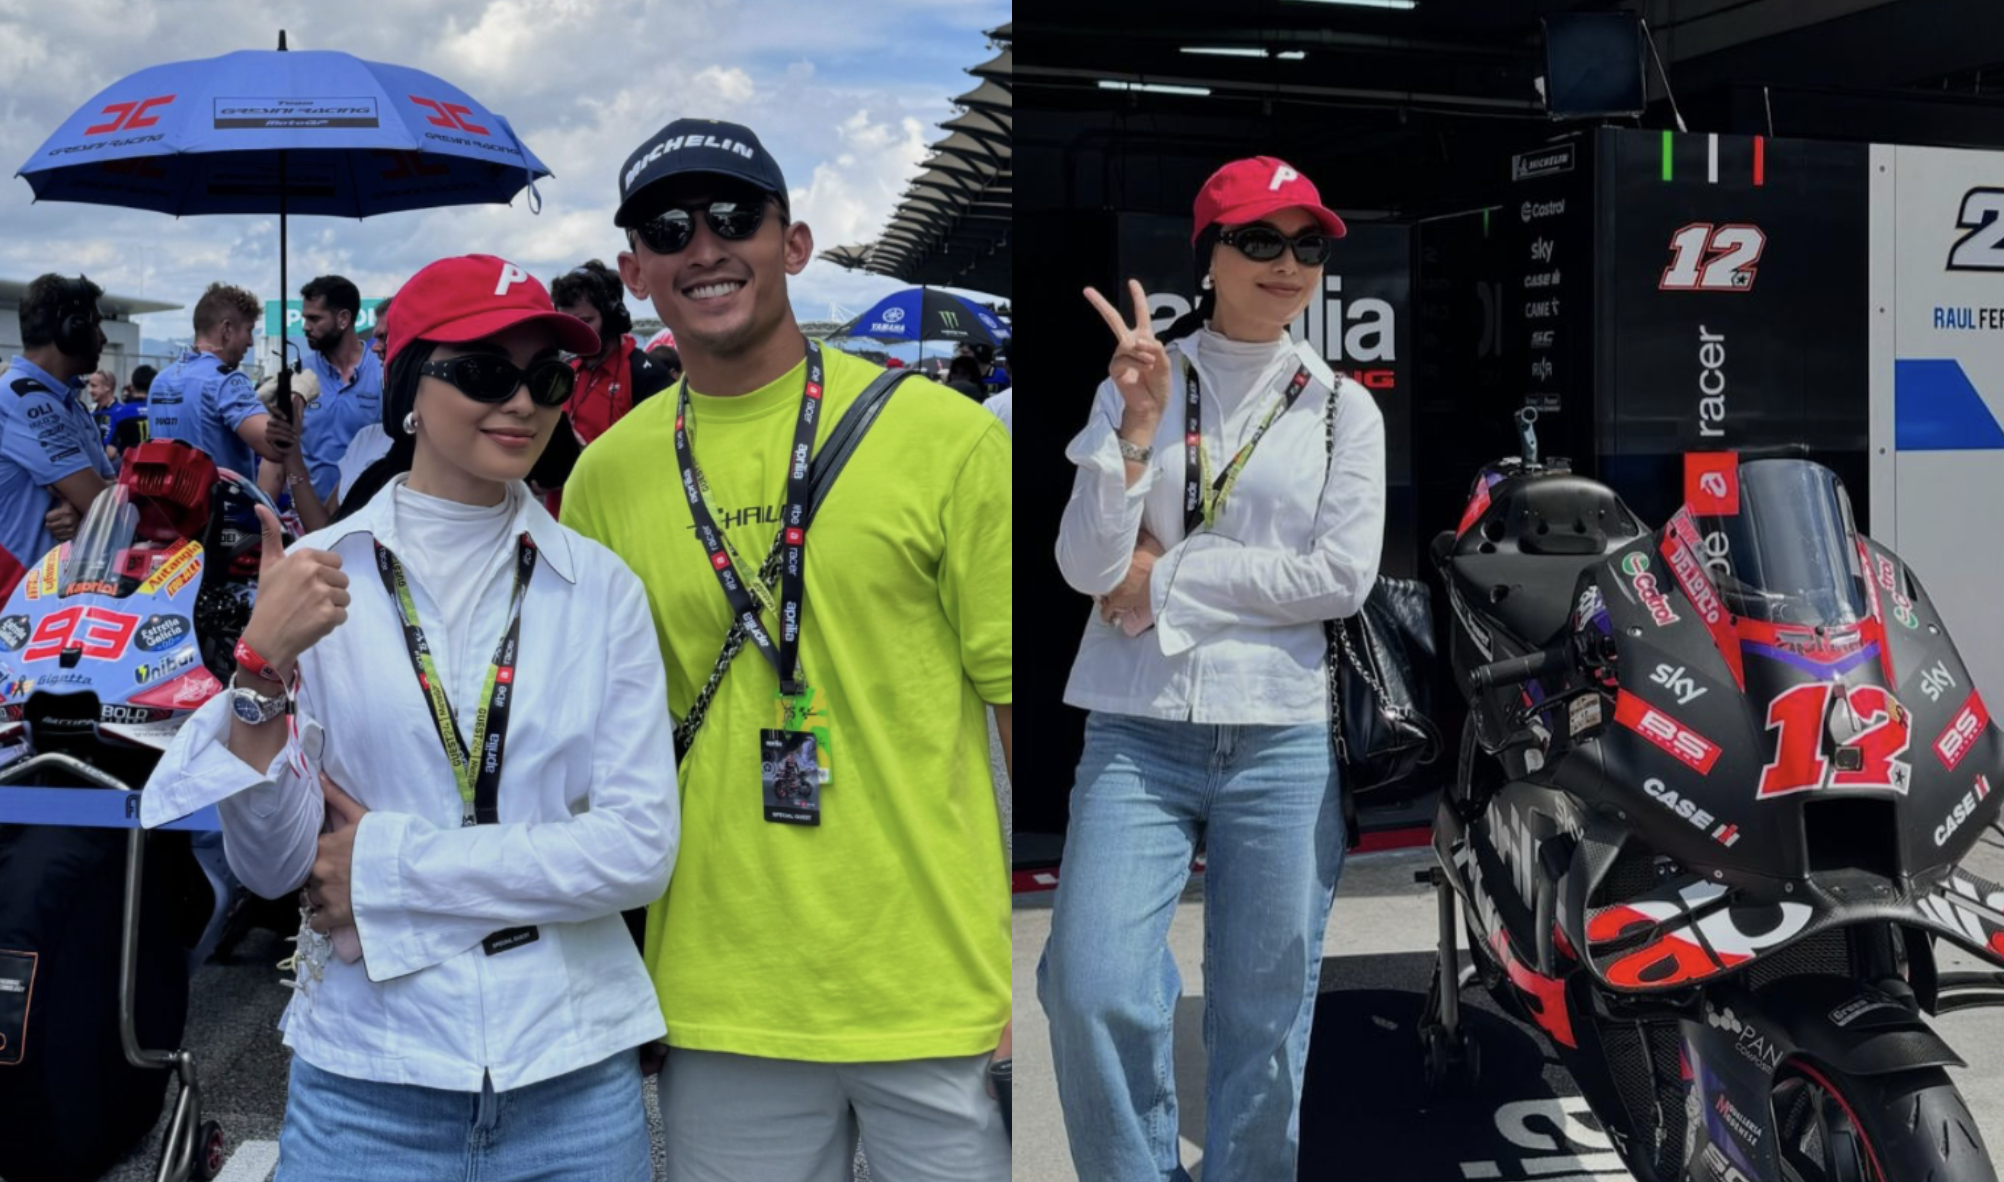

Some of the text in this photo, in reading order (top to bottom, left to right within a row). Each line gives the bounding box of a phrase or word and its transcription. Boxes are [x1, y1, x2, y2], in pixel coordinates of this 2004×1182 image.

[265, 119, 329, 127] MotoGP
[625, 134, 754, 191] MICHELIN
[1268, 165, 1298, 190] P
[1532, 199, 1565, 218] Castrol
[1531, 237, 1554, 263] sky
[1658, 222, 1767, 291] 12
[493, 262, 527, 295] P
[1524, 272, 1551, 288] CASE
[869, 322, 905, 334] YAMAHA
[1934, 306, 1976, 330] RAUL
[1699, 325, 1725, 436] racer
[804, 398, 815, 424] racer
[794, 443, 808, 480] aprilia
[791, 503, 802, 524] #be
[702, 525, 719, 552] racer
[788, 547, 798, 577] racer
[22, 605, 141, 663] 93
[141, 618, 180, 642] Estrella
[146, 626, 183, 647] Galicia
[742, 611, 770, 647] aprilia
[785, 601, 798, 642] aprilia
[502, 640, 515, 666] racer
[494, 685, 508, 708] #be
[1649, 663, 1709, 705] sky
[1920, 660, 1956, 701] sky
[101, 704, 149, 719] BOLD
[1639, 709, 1711, 760] BS
[1756, 682, 1912, 800] 12
[1938, 706, 1978, 761] BS
[485, 733, 501, 775] aprilia
[1643, 777, 1715, 831] CASE
[1934, 792, 1976, 847] CASE
[1739, 1024, 1784, 1067] PAN
